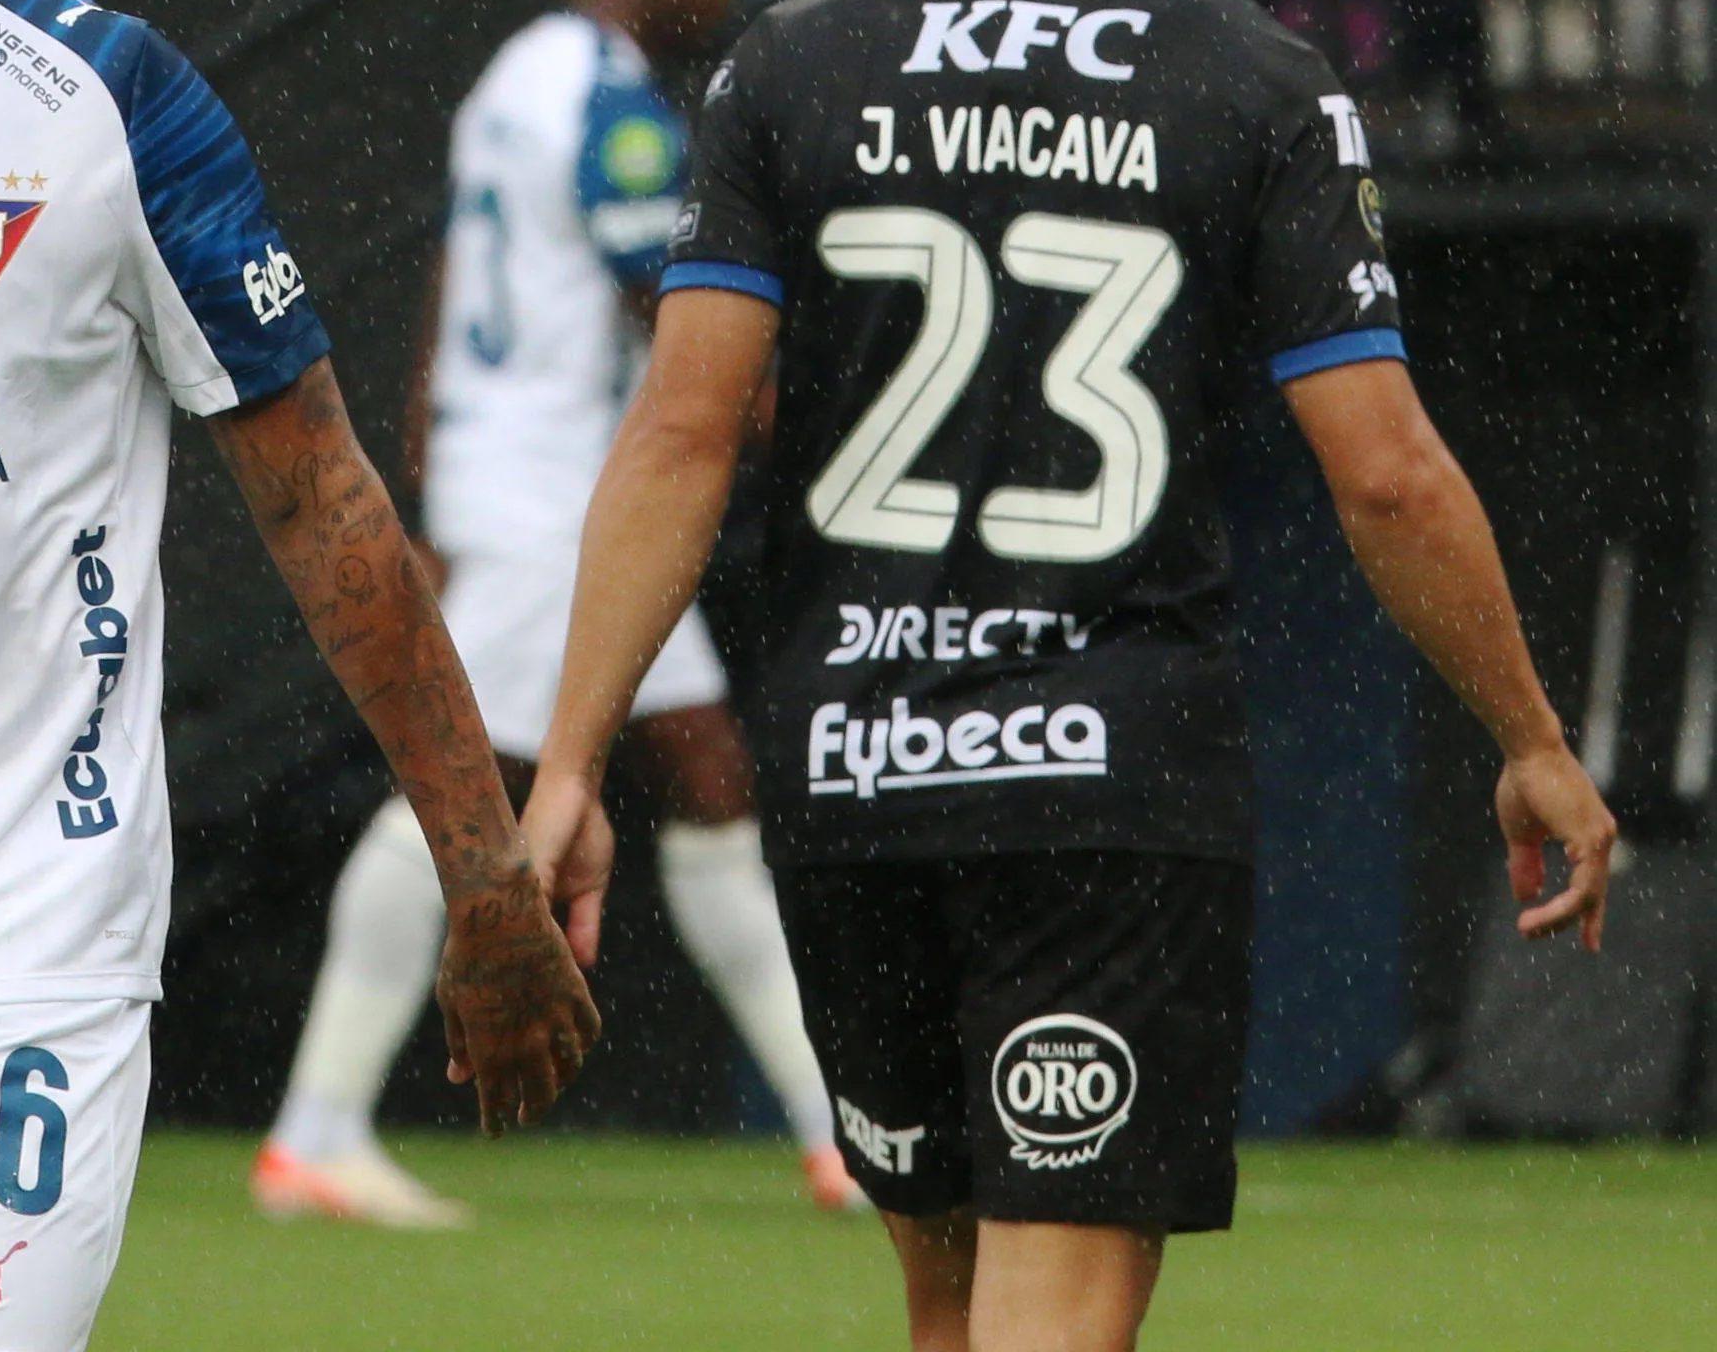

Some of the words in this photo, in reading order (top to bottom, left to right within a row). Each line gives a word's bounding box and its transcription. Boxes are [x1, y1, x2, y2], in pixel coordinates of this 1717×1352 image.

[899, 0, 1152, 80] KFC
[5, 63, 63, 113] maresa
[855, 106, 911, 175] J.
[928, 104, 1158, 193] VIACAVA
[805, 205, 1184, 564] 23
[824, 604, 1105, 665] DIRECTV
[808, 697, 1108, 799] Fybeca
[1027, 1042, 1076, 1059] PALMA
[1007, 1060, 1118, 1120] ORO
